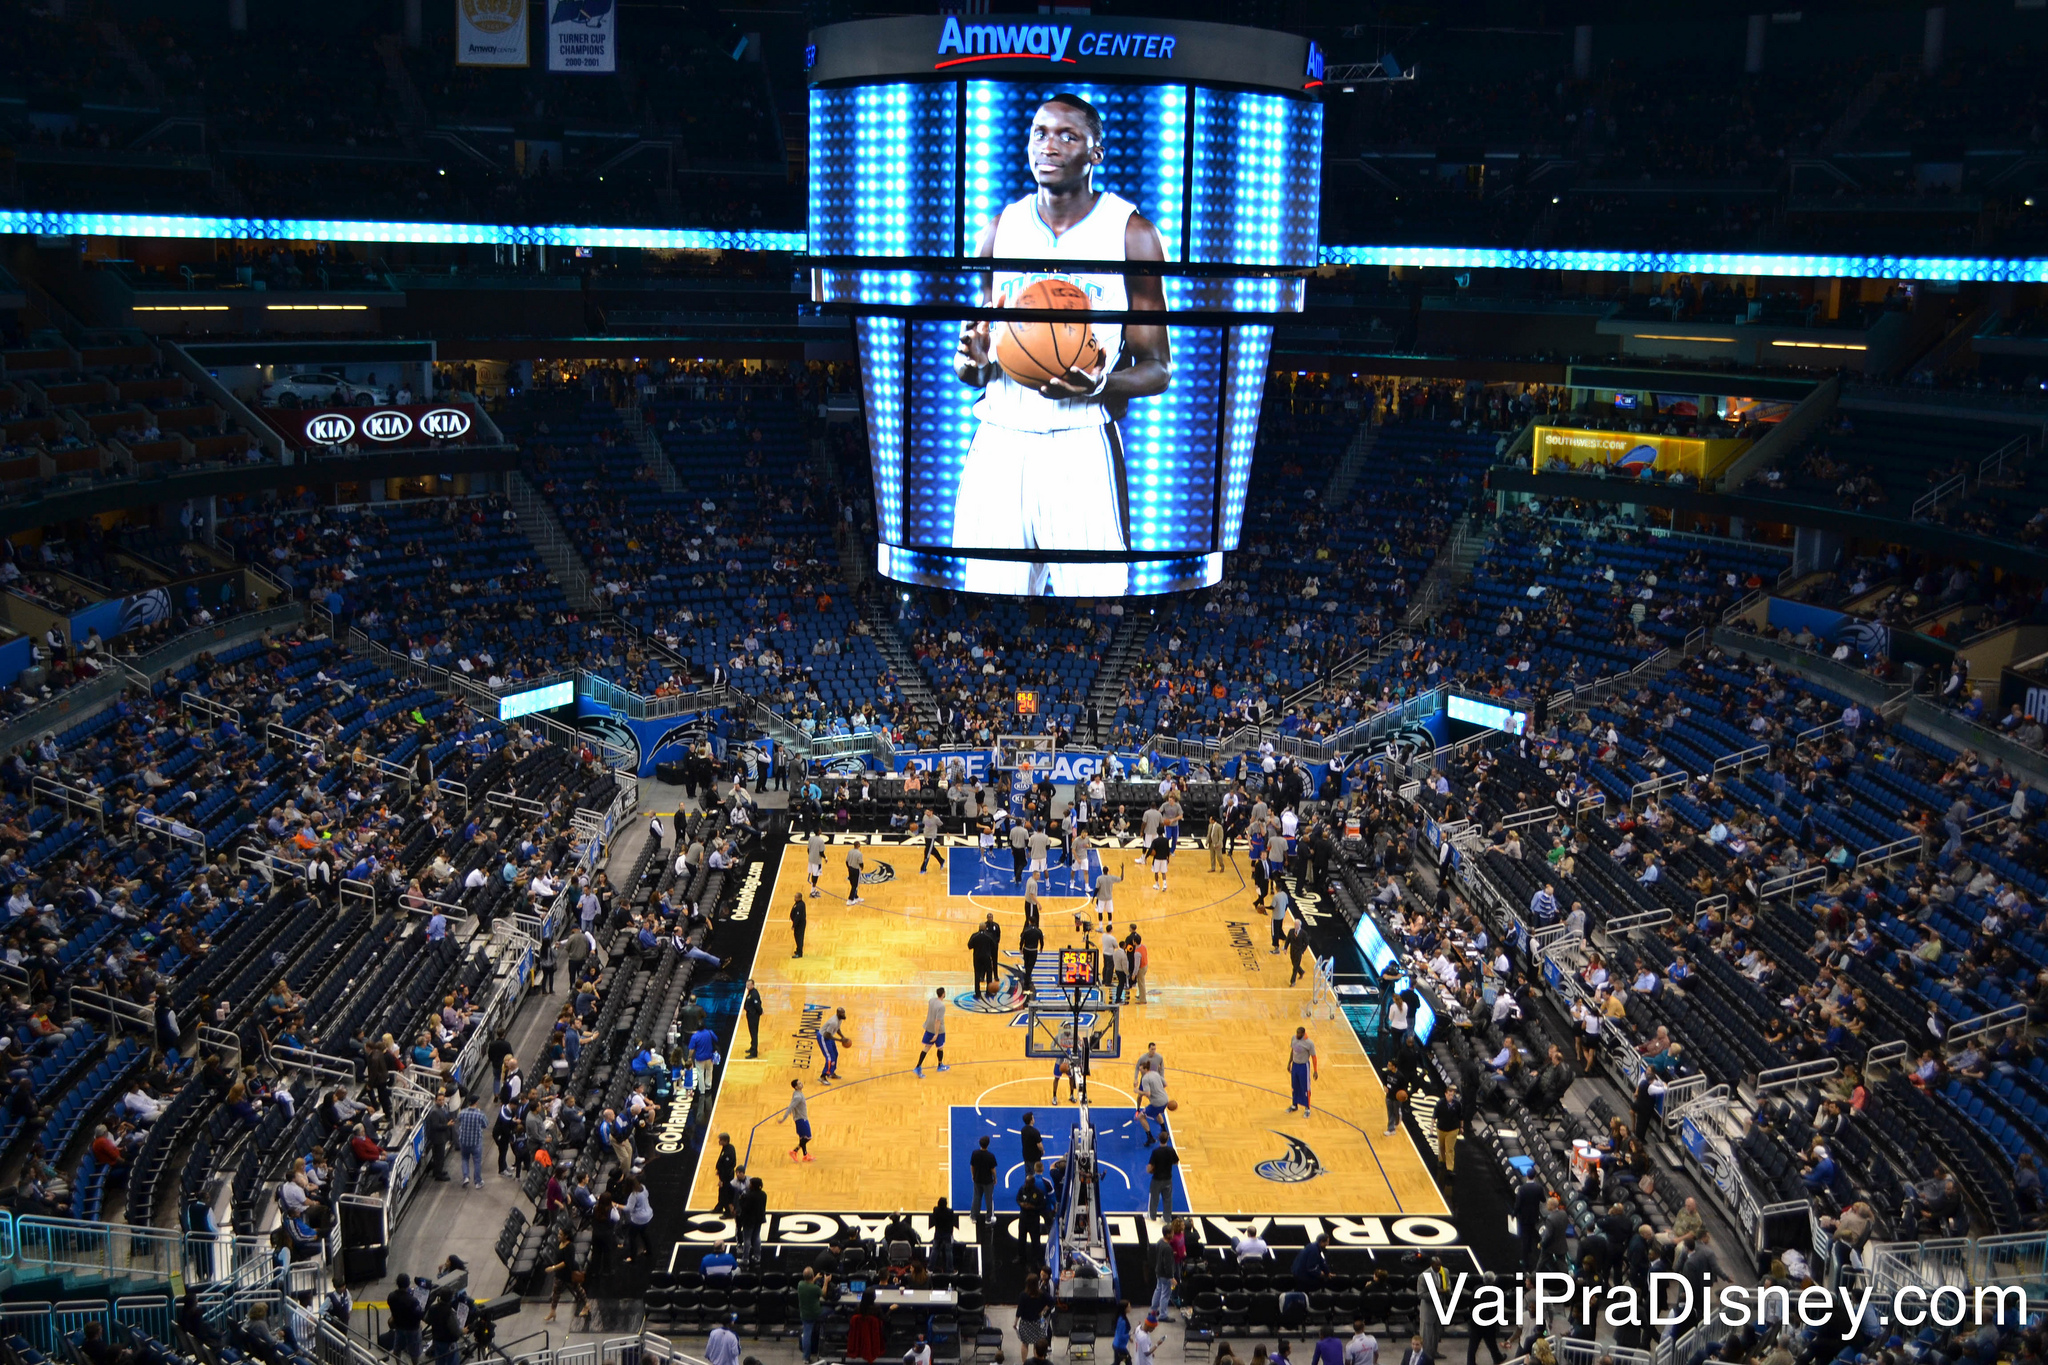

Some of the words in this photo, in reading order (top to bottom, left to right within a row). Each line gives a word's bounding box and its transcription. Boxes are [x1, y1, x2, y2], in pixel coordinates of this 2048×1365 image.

[558, 33, 589, 44] TURNER
[590, 33, 606, 44] CUP
[937, 17, 1073, 62] Amway
[1077, 32, 1177, 60] CENTER
[468, 44, 498, 55] Amway
[560, 45, 605, 55] CHAMPIONS
[565, 58, 600, 67] 2000-2001
[1019, 700, 1035, 713] 24
[730, 861, 764, 921] OrlandoMagic.com
[1224, 920, 1255, 950] Amway
[1066, 963, 1090, 982] 24
[792, 1003, 832, 1040] Amway
[792, 1040, 814, 1070] CENTER
